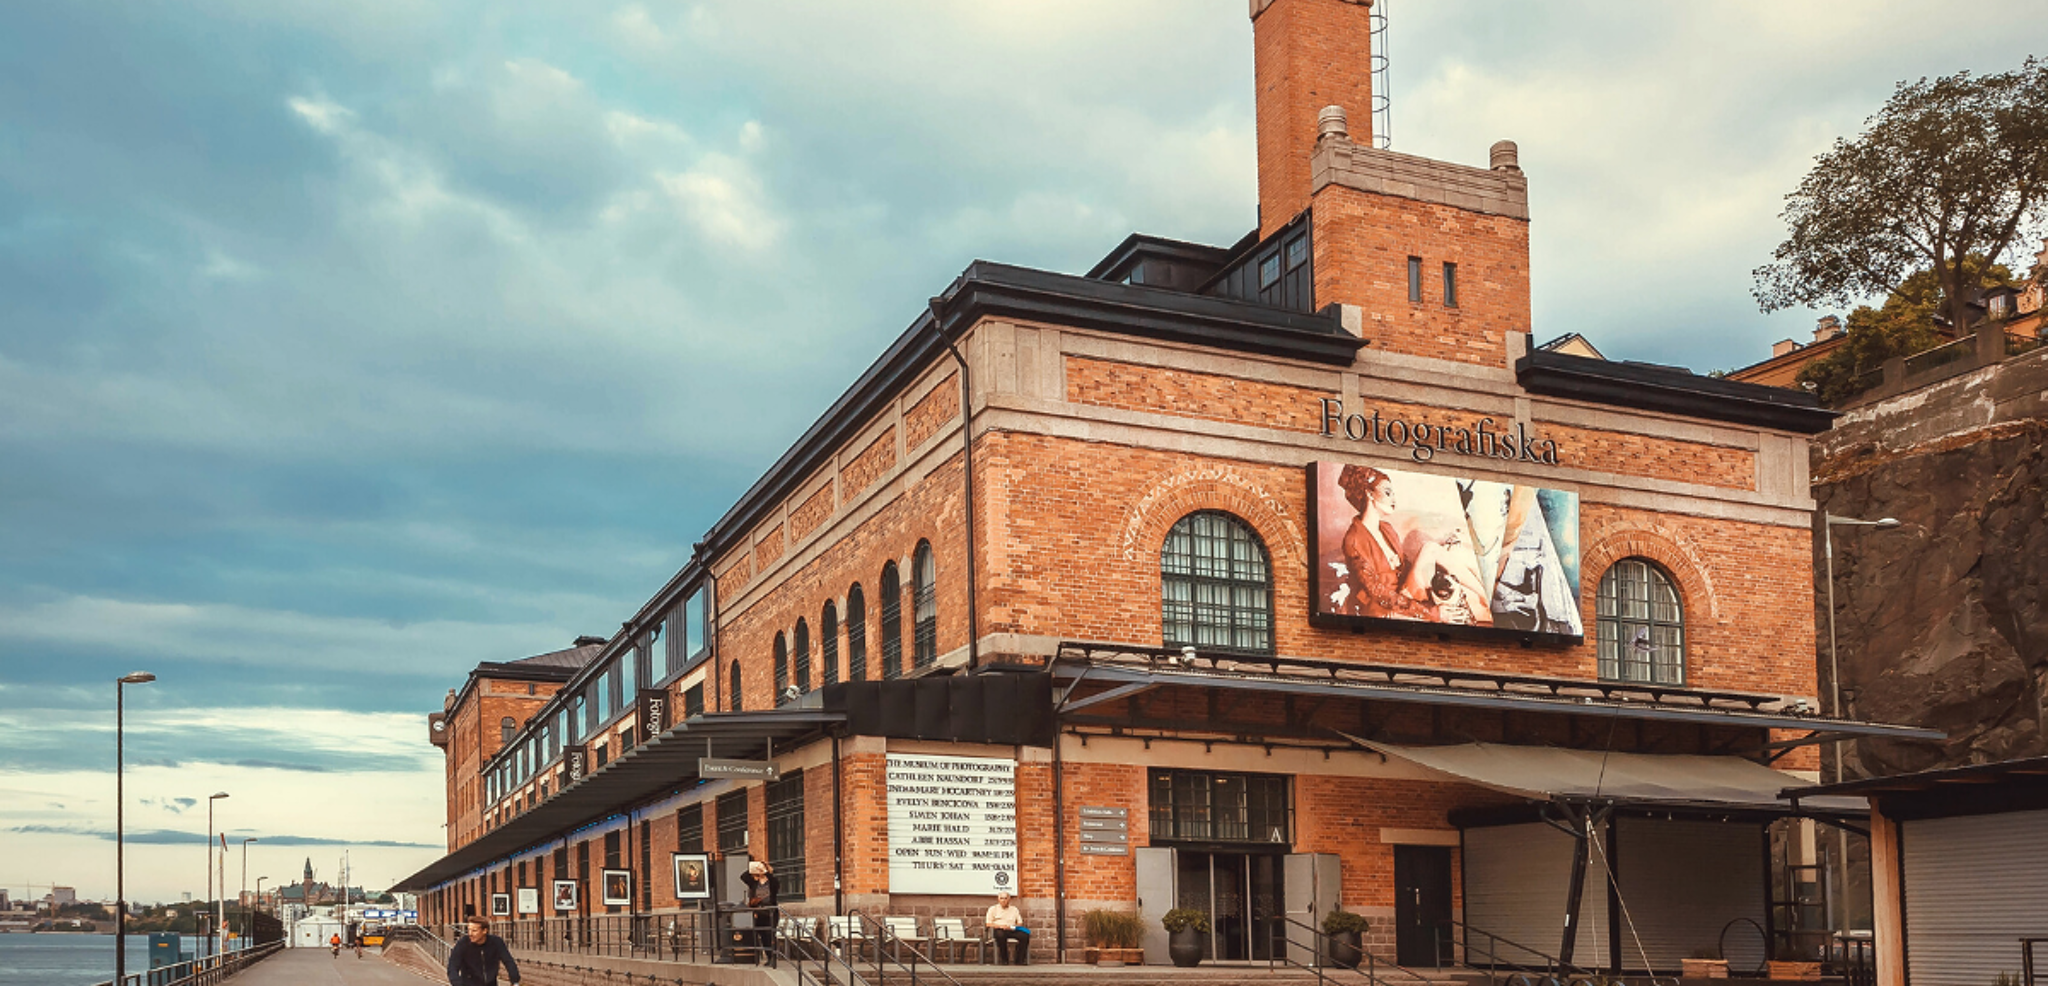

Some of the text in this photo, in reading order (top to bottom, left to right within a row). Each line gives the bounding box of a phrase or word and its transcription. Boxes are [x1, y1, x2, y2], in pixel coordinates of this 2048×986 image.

[1319, 397, 1560, 465] Fotografiska
[903, 760, 938, 769] MUSEUM
[940, 762, 949, 770] OF
[951, 762, 1011, 772] PHOTOGRAPHY
[888, 772, 934, 782] CATHLEEN
[936, 774, 984, 784] NAUNDORF
[896, 798, 929, 806] EVELYN
[912, 823, 941, 832] MARIE
[1271, 827, 1282, 842] A
[936, 837, 970, 845] HASSAN
[895, 848, 919, 857] OPEN
